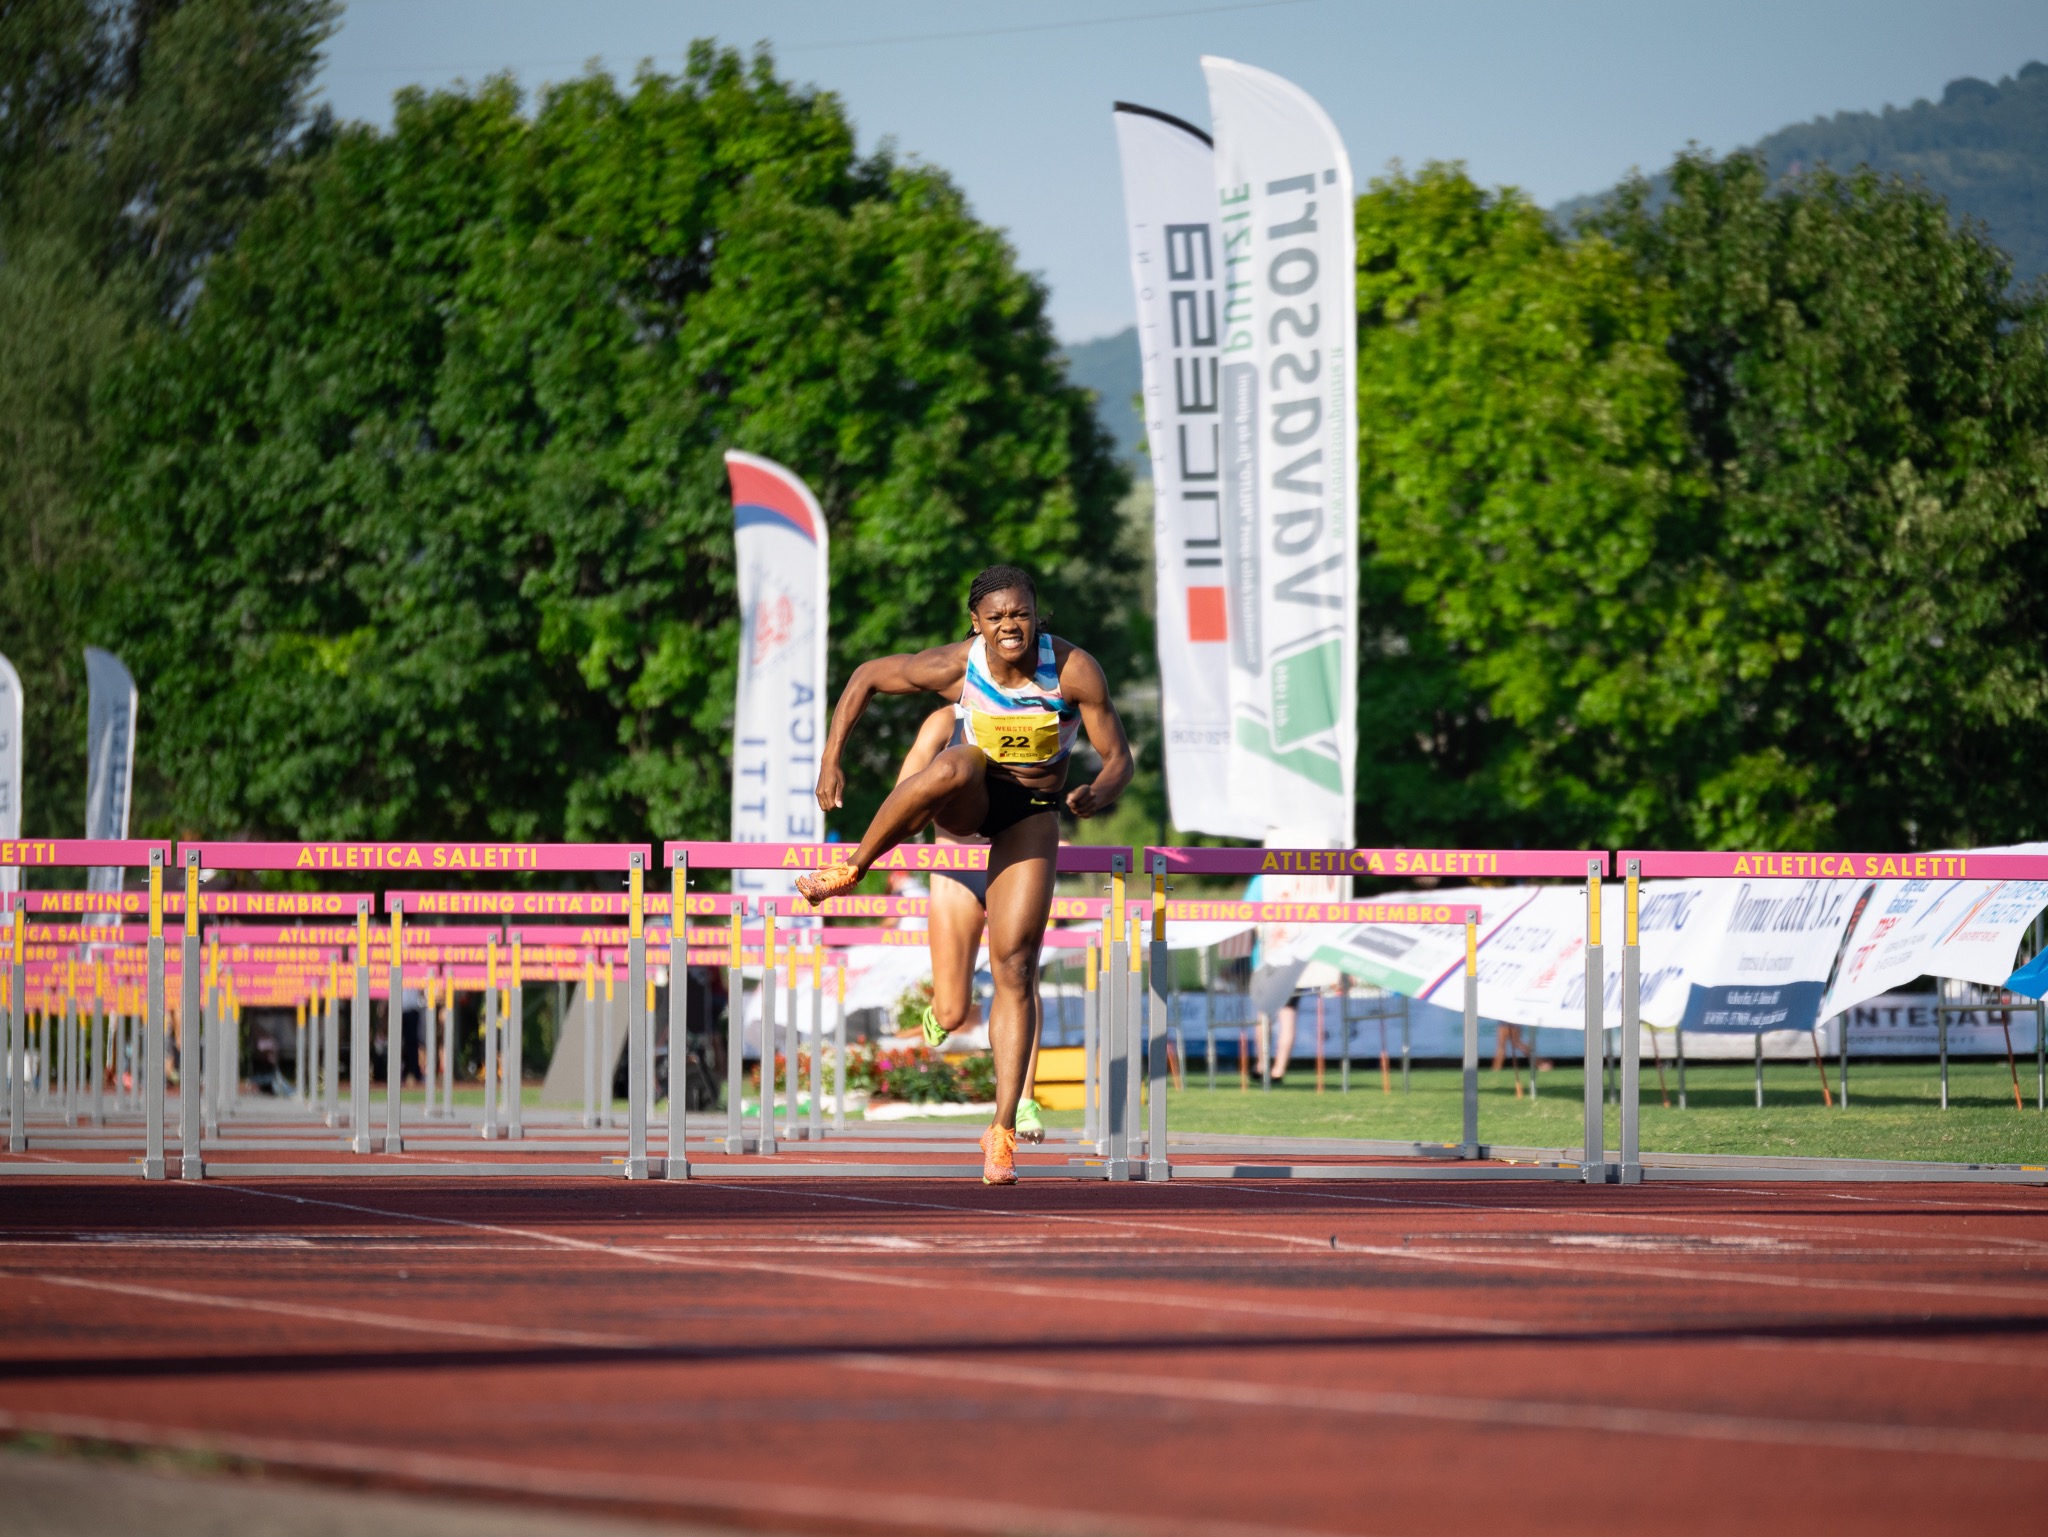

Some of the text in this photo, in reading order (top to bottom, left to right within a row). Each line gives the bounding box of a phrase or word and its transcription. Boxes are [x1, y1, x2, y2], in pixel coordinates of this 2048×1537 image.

[1000, 735, 1031, 748] 22
[1, 842, 57, 863] ETTI
[297, 847, 538, 868] ATLETICA SALETTI
[781, 847, 992, 869] ATLETA SALET
[1261, 851, 1497, 873] ATLETICA SALETTI
[1733, 855, 1967, 877] ATLETICA SALETTI
[41, 894, 140, 912] MEETING
[215, 895, 239, 912] DI
[247, 895, 343, 913] NEMBRO
[417, 895, 515, 912] MEETING
[590, 896, 613, 913] DI
[621, 896, 717, 914] NEMRO
[1165, 903, 1254, 920] MEETING
[1327, 905, 1350, 921] DI
[1357, 905, 1452, 923] NEMBRO
[57, 927, 125, 942] SALETTI
[278, 929, 431, 945] ATLETICA SALTTI
[580, 929, 731, 945] ATLETA SLETTI
[881, 930, 929, 945] ATLET
[253, 948, 320, 963] NEMBRO
[371, 948, 439, 962] METING
[522, 949, 577, 963] EMBRO
